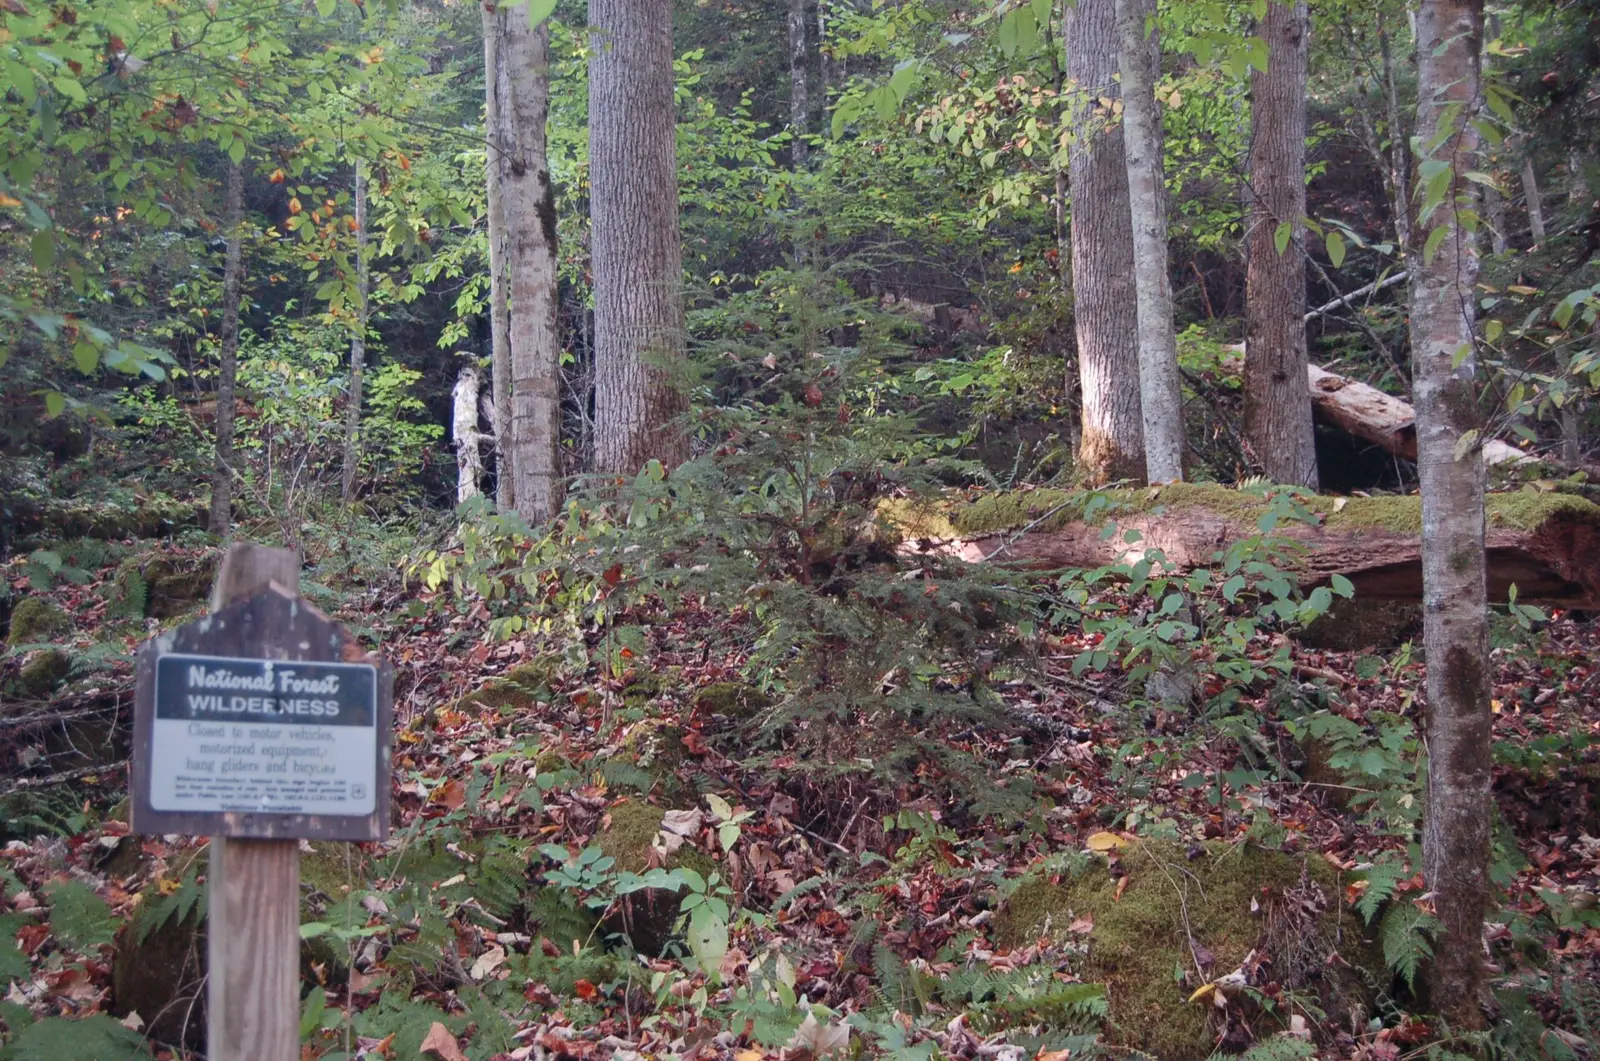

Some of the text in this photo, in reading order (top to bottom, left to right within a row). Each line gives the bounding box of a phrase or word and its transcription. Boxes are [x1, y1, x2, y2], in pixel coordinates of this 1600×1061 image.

[188, 666, 340, 694] National Forest
[188, 695, 340, 716] WILDERNESS
[188, 723, 225, 737] Closed
[232, 727, 243, 739] to
[249, 728, 282, 740] motor
[199, 741, 255, 756] motorized
[187, 756, 215, 774] hang
[221, 757, 259, 774] gliders
[266, 759, 287, 774] and
